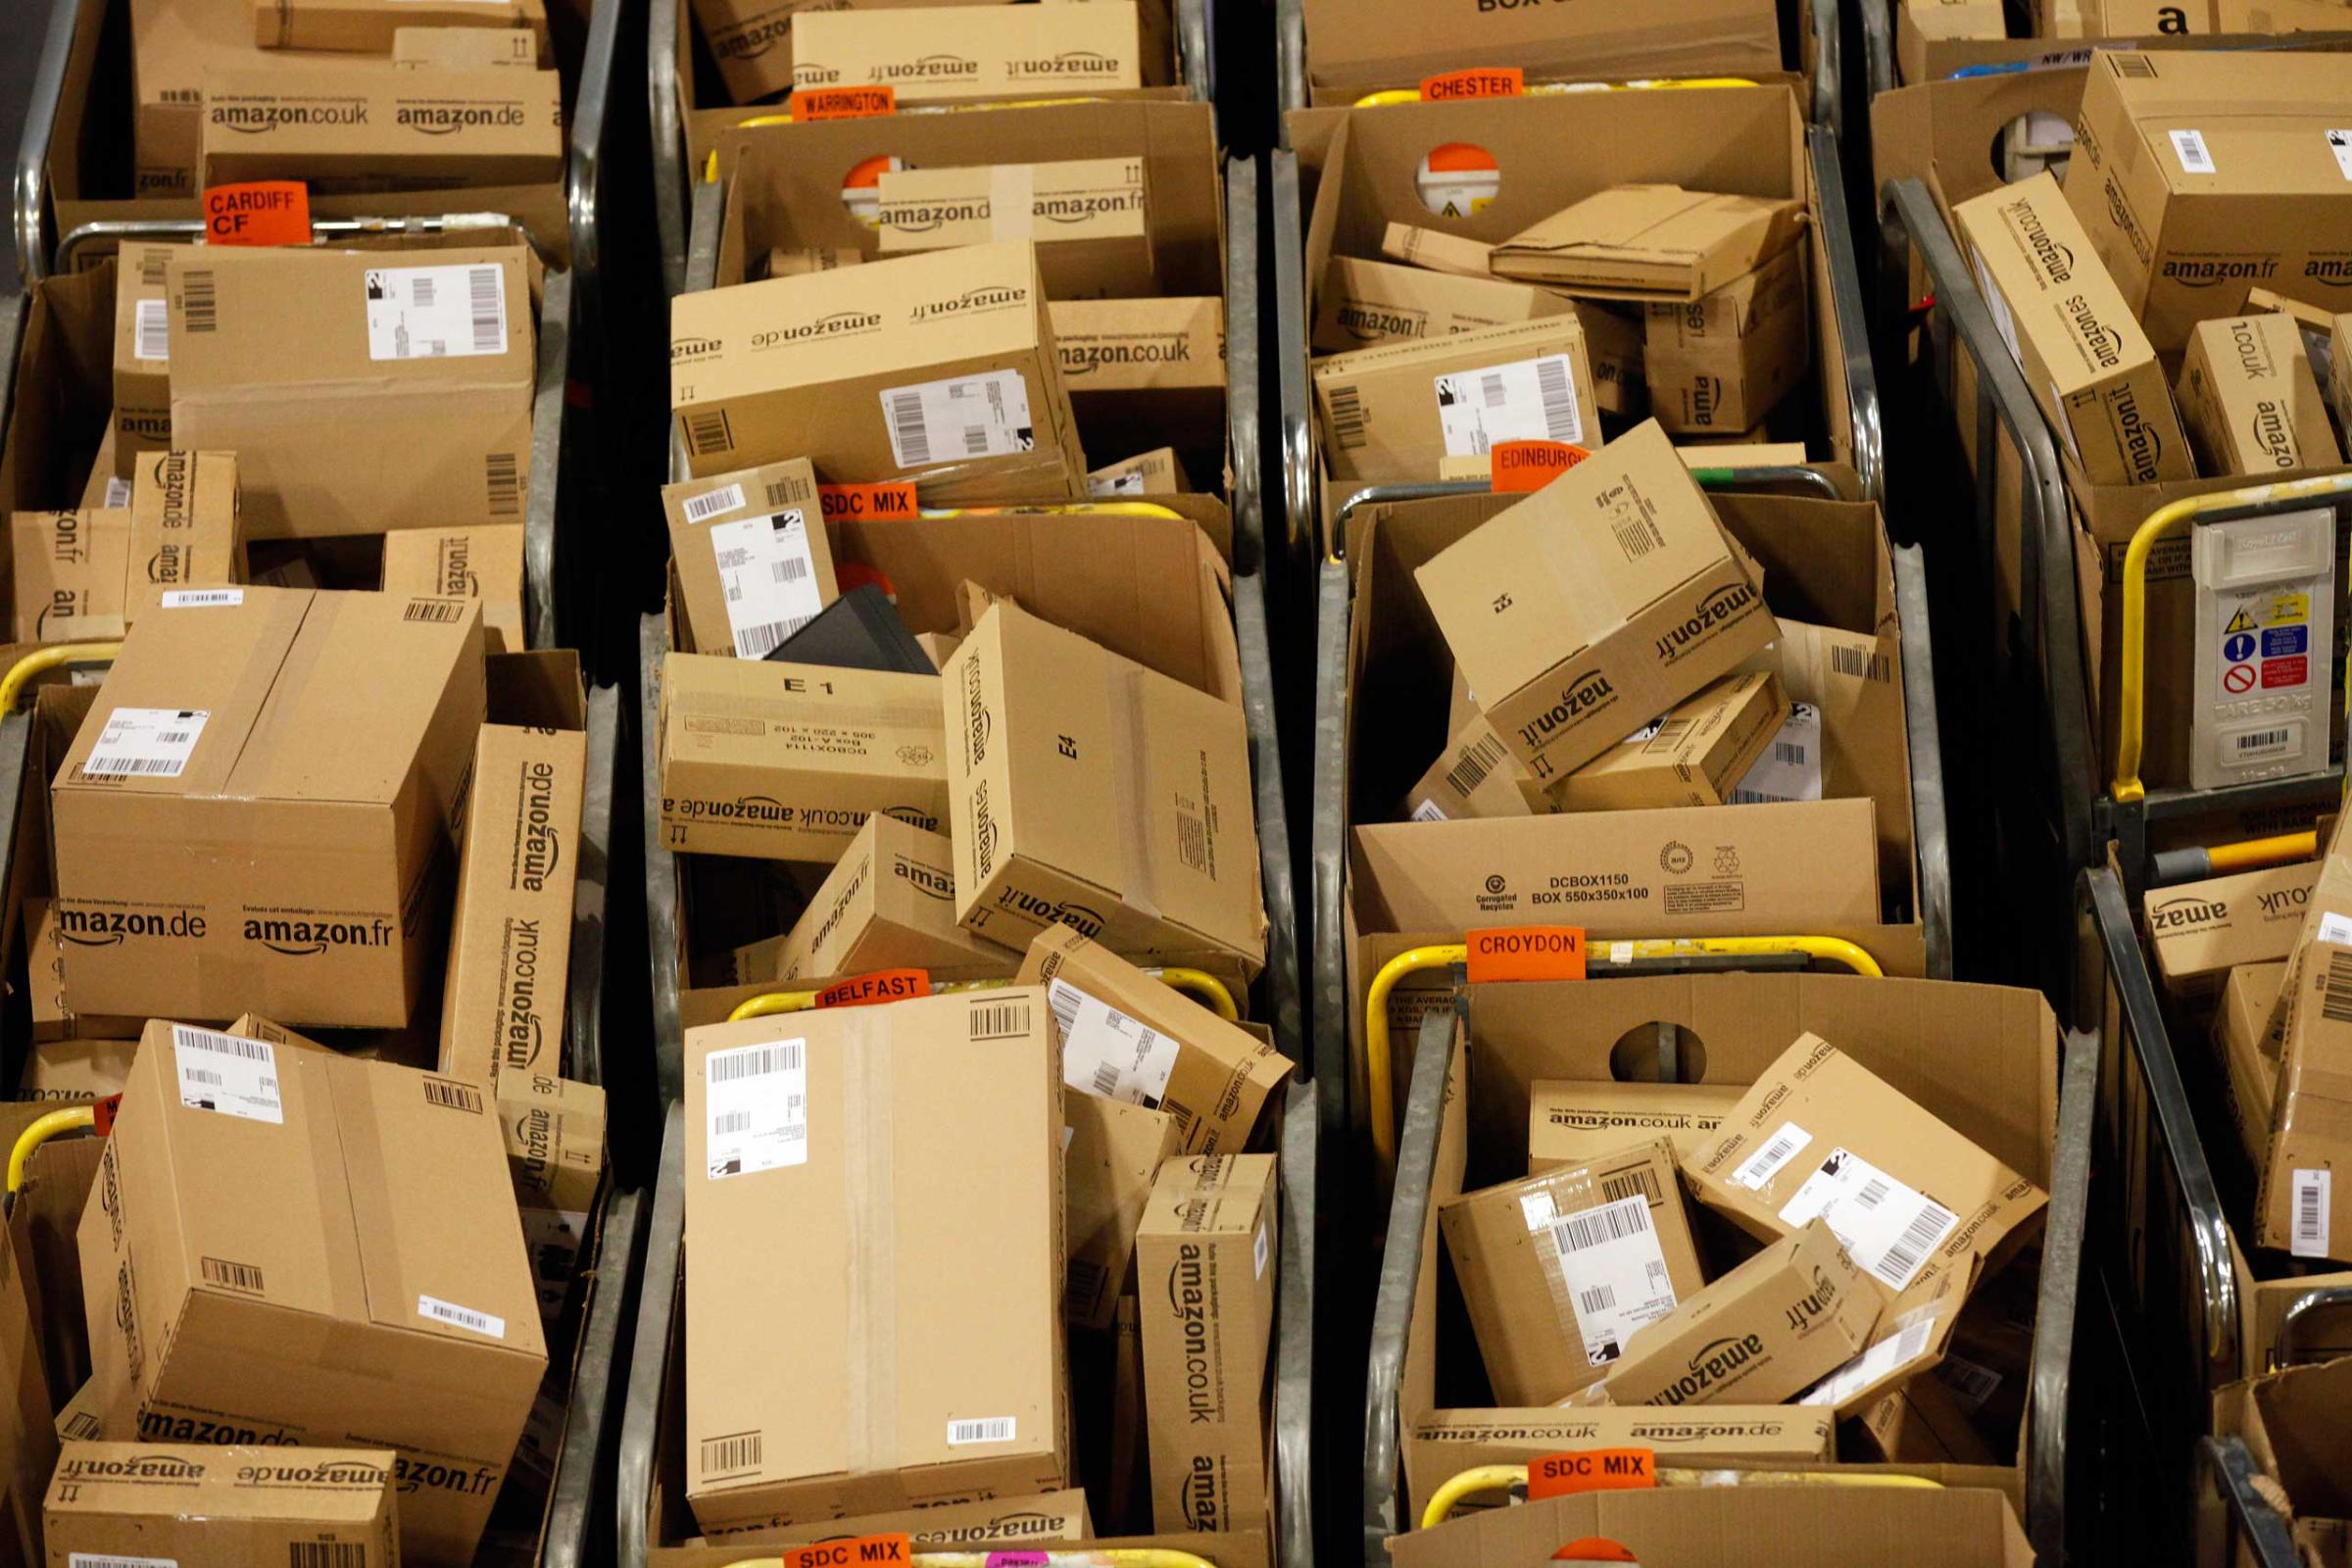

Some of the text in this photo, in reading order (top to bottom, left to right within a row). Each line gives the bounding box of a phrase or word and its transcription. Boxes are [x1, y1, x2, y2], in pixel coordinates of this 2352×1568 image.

[1430, 75, 1513, 99] CHESTER
[211, 100, 368, 124] amazon.co.uk
[397, 104, 525, 125] amazon.de
[805, 91, 890, 114] WARRINGTON
[2077, 121, 2102, 172] zon.de
[140, 171, 188, 188] zon.fr
[210, 190, 295, 215] CARDIFF
[878, 199, 990, 225] amazon.d
[213, 214, 250, 236] CF
[2162, 257, 2279, 280] amazon.fr
[908, 288, 1027, 319] amazon.fr
[751, 314, 882, 347] amazon.de
[1337, 307, 1428, 338] amazon.it
[2065, 294, 2120, 368] amazon.es
[1057, 339, 1190, 366] mazon.co.uk
[2257, 401, 2294, 467] amazo
[821, 489, 909, 515] SDC MIX
[54, 509, 80, 565] zon.fr
[447, 536, 469, 599] azon.it
[1517, 676, 1614, 748] mazon.it
[680, 798, 794, 819] amazon.de
[522, 762, 555, 893] amazon.de
[1549, 872, 1629, 889] DCBOX1150
[1531, 887, 1649, 905] BOX 550x350x100
[60, 909, 207, 938] mazon.de
[998, 886, 1102, 938] mazon.it
[244, 919, 394, 947] amazon.fr
[1480, 933, 1577, 955] CROYDON
[824, 976, 918, 1006] BELFAST
[1549, 1113, 1691, 1129] amazon.co.uk
[1944, 1202, 2001, 1258] amazon.co.uk
[1180, 1243, 1216, 1424] amazon.co.uk
[1413, 1423, 1597, 1442] amazon.co.uk
[1629, 1421, 1782, 1440] amazon.de
[64, 1458, 206, 1480] amazon.fr
[394, 1457, 498, 1497] azon.fr
[1544, 1454, 1644, 1480] SDC MIX
[800, 1541, 901, 1568] SDC MIX
